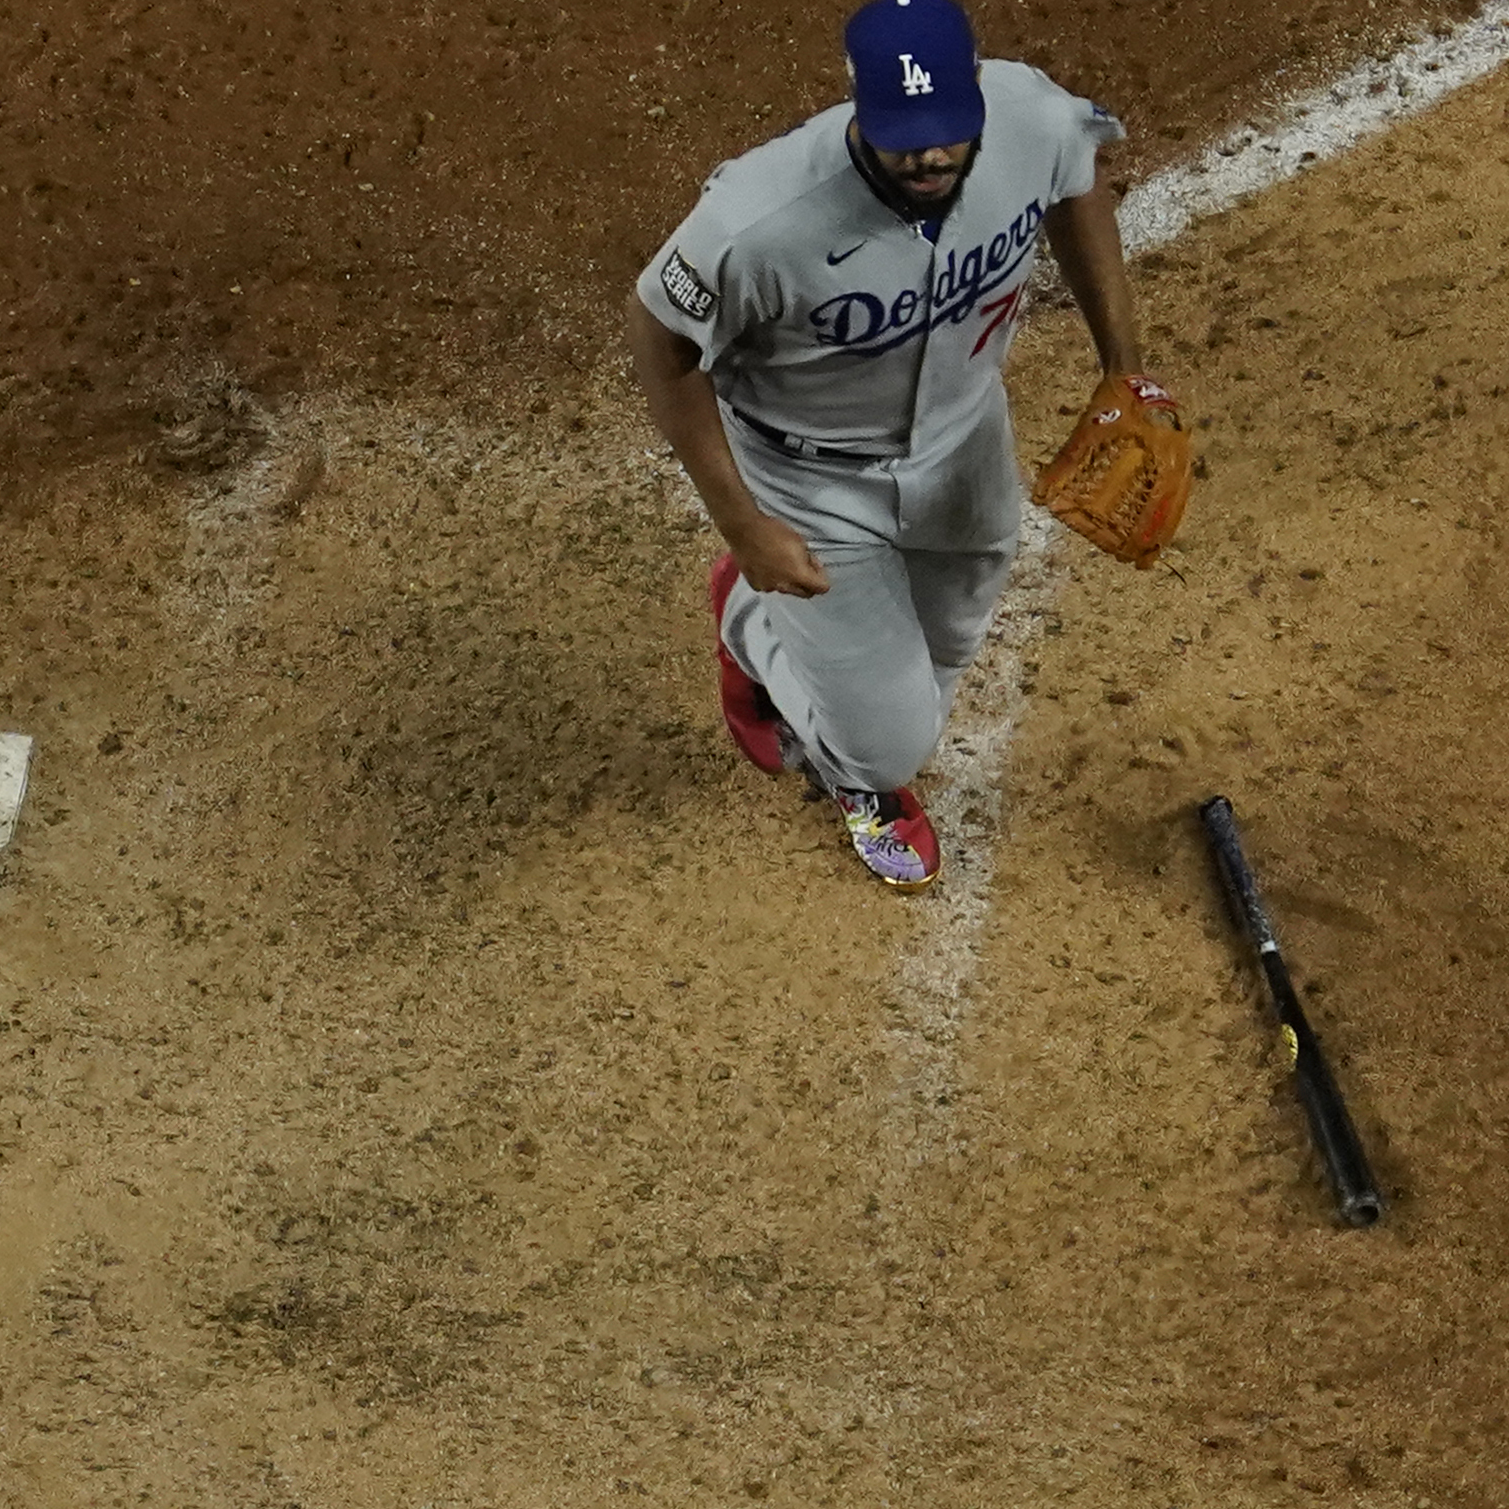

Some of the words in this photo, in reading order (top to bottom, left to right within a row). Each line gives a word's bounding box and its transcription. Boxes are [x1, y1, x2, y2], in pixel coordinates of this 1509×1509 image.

[898, 54, 934, 96] LA
[662, 266, 707, 318] SERIES
[670, 253, 713, 306] WORLD
[809, 197, 1045, 347] Dodgers
[969, 282, 1025, 361] 7
